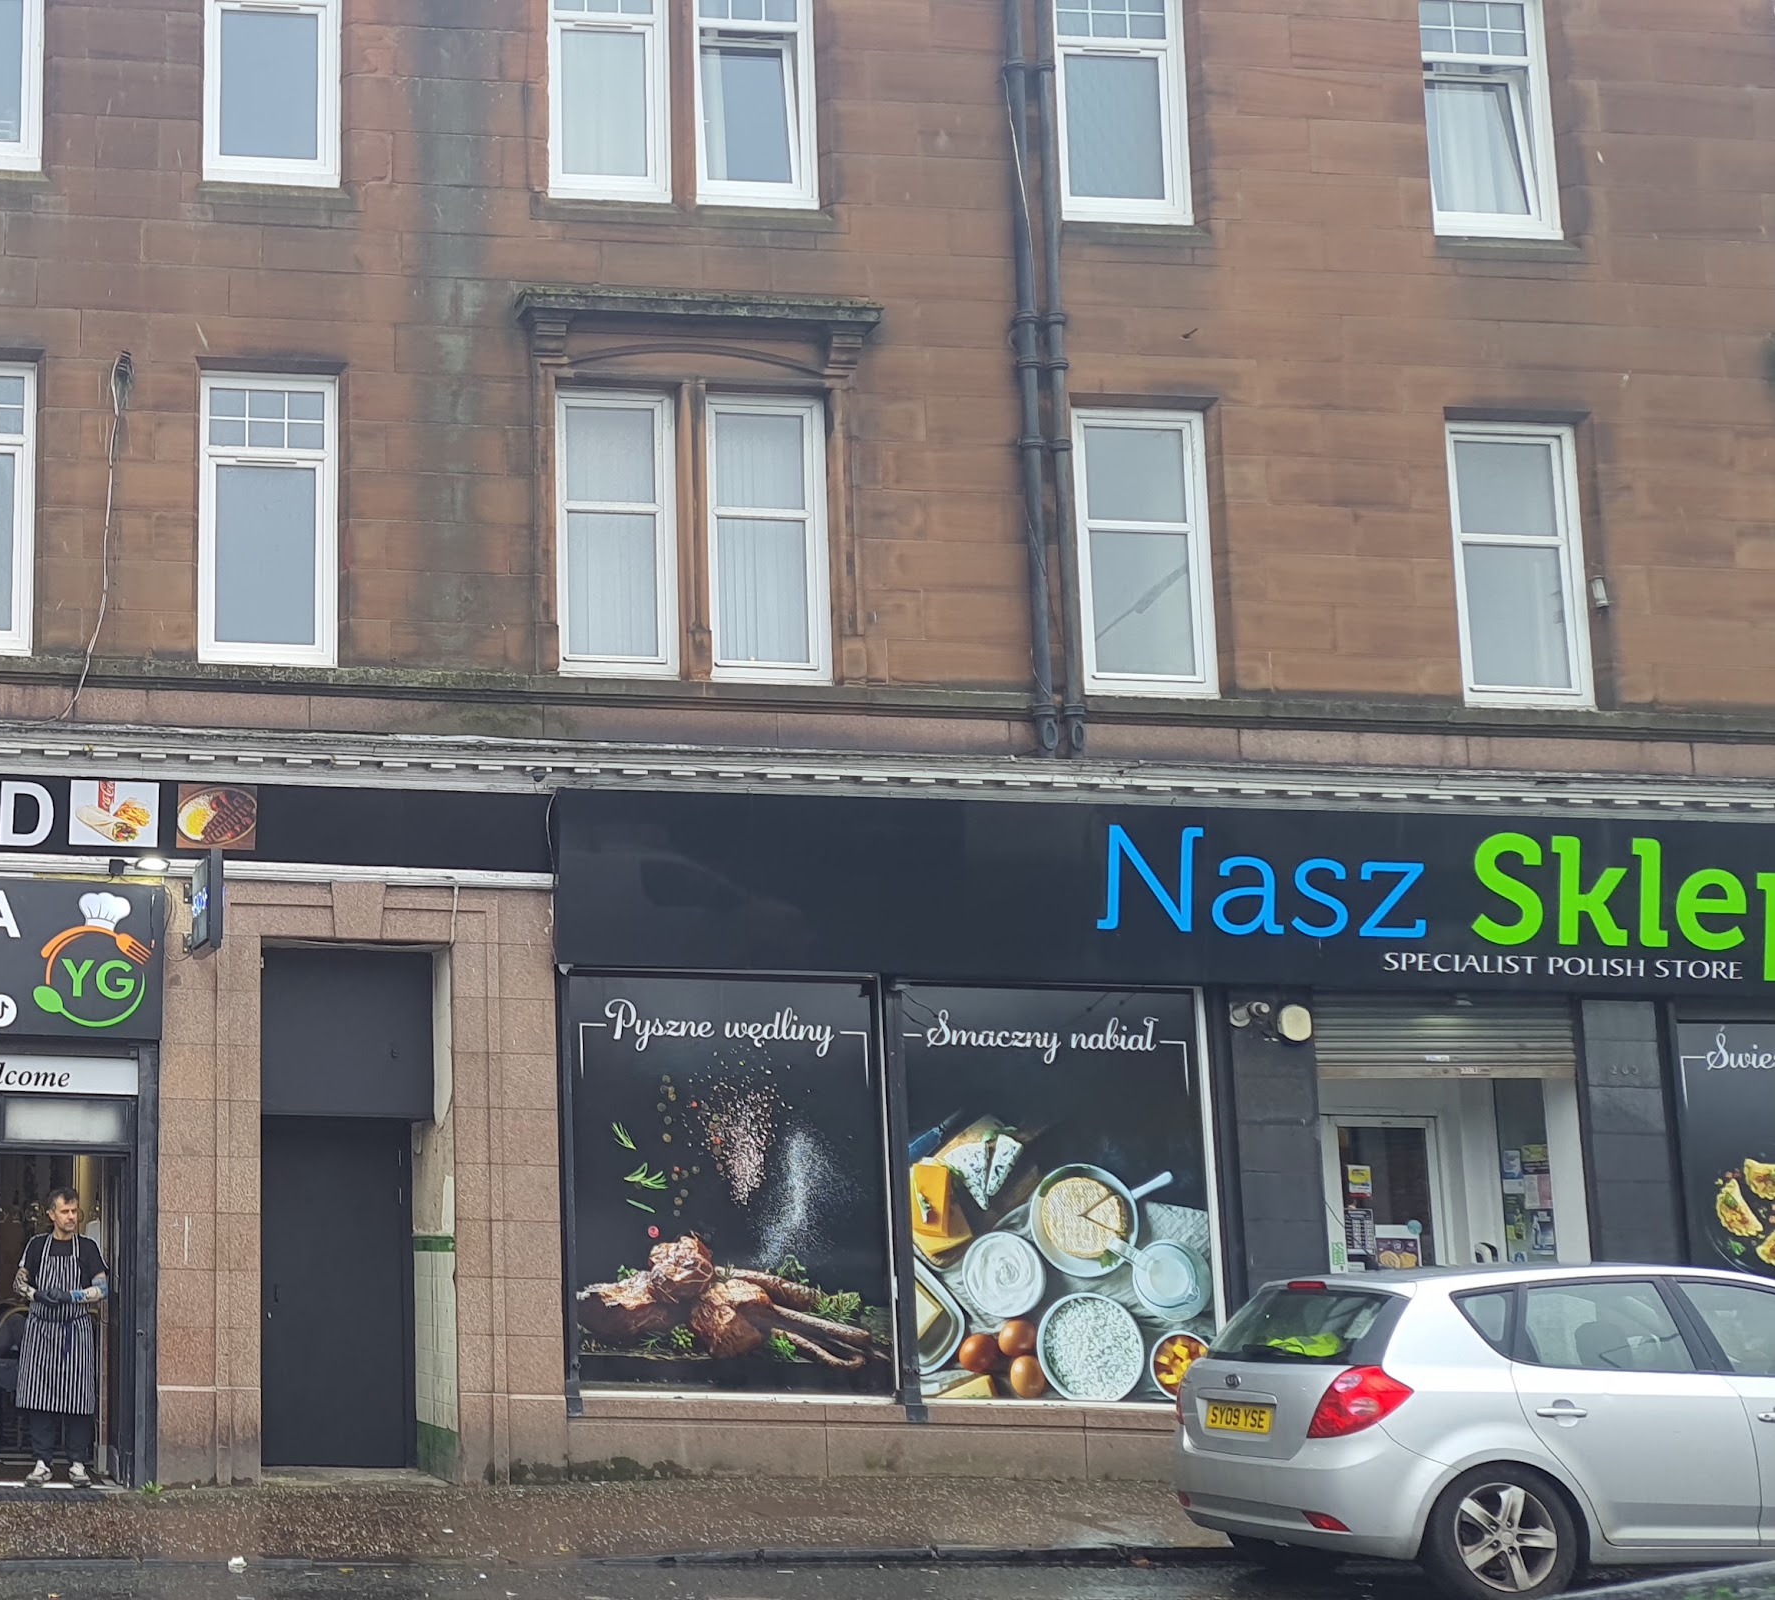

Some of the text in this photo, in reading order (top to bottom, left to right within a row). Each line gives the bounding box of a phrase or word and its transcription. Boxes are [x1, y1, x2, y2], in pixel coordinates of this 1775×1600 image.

[1096, 823, 1427, 938] Nasz
[61, 957, 135, 1000] YG
[1383, 951, 1743, 980] SPECIALIST POLISH STORE
[604, 998, 835, 1058] Pyszne wędliny
[926, 1009, 1062, 1065] Smaczny
[1706, 1024, 1775, 1071] Świe
[1210, 1405, 1267, 1429] SY09 YSE
